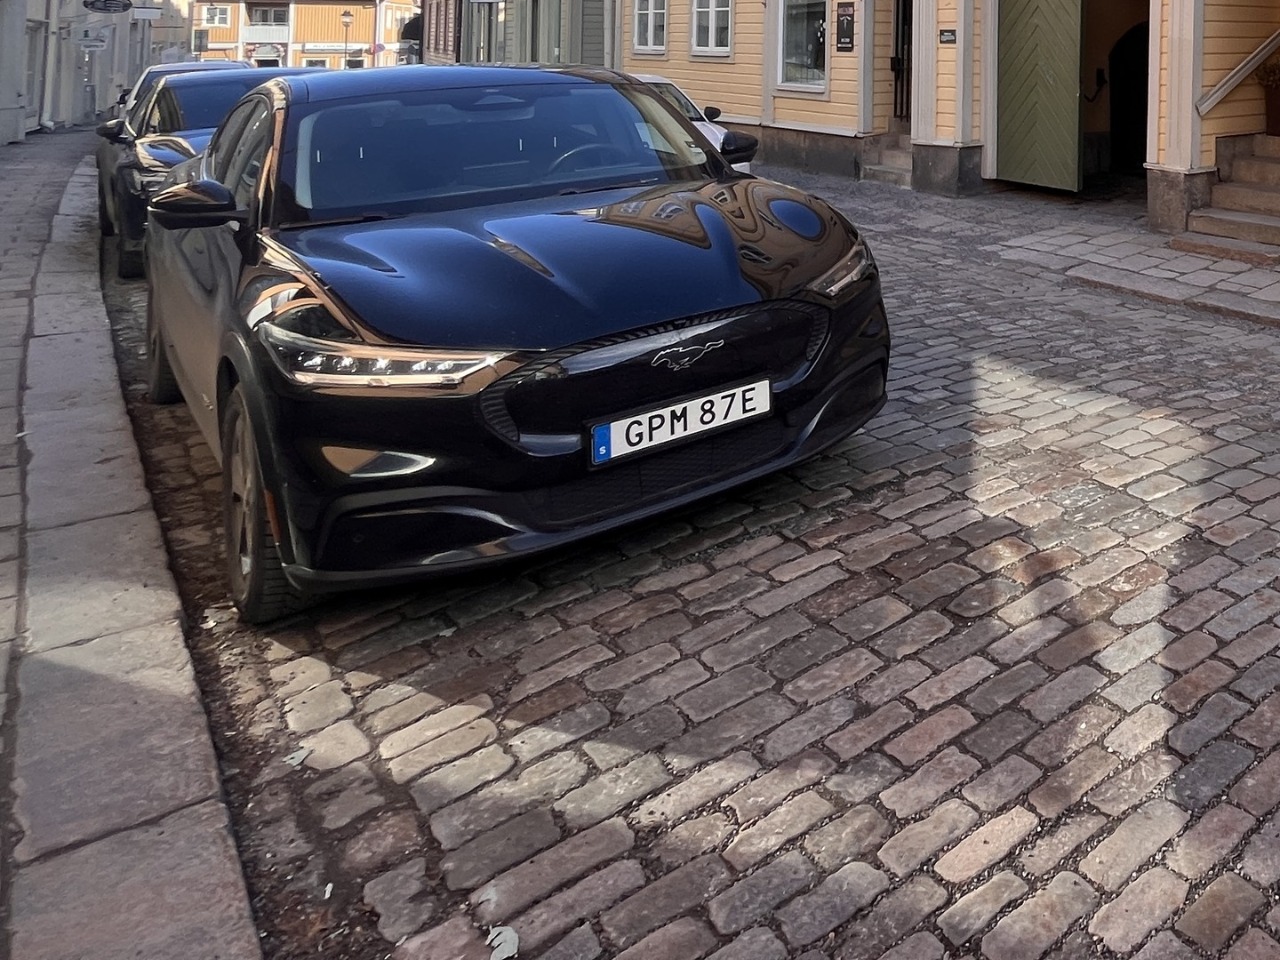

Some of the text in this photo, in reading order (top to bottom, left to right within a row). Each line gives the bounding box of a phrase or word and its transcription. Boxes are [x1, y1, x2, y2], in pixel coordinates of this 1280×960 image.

[625, 386, 757, 447] GPM 87E
[599, 445, 607, 455] S
